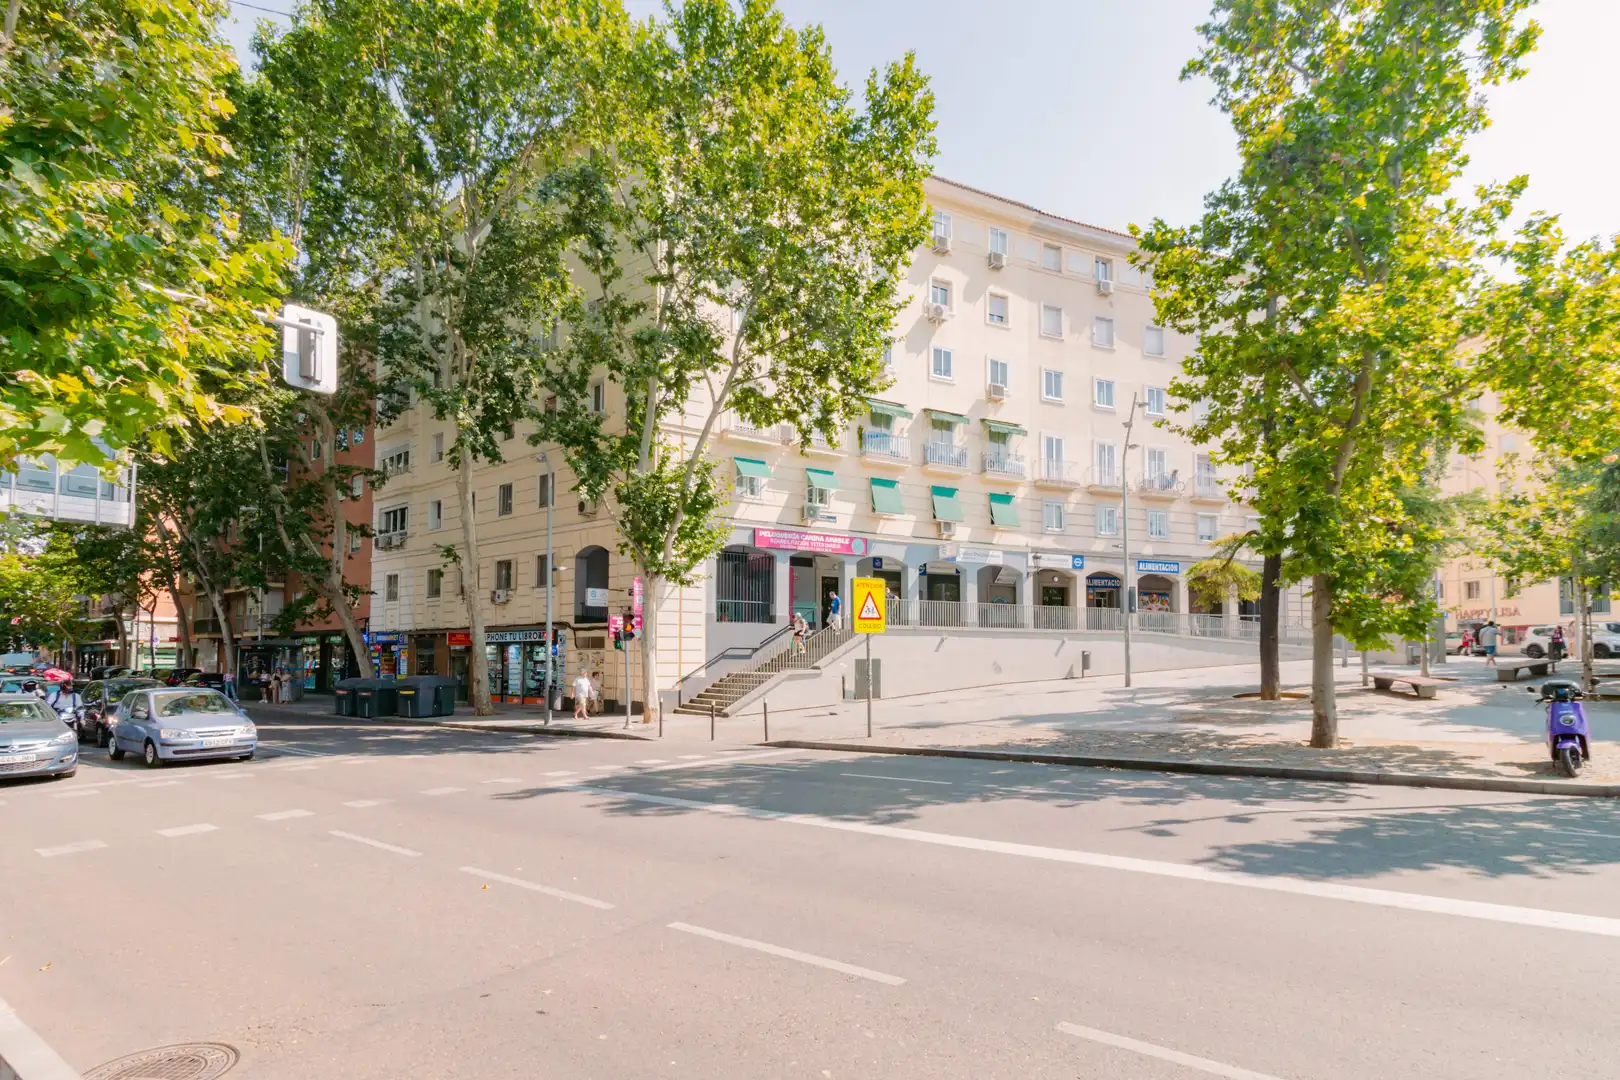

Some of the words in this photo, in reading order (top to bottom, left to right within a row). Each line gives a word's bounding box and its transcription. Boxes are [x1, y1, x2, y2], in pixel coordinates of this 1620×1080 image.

[800, 534, 825, 543] CANINA
[1138, 562, 1178, 572] ALIMENTACION
[509, 632, 517, 640] TU
[518, 631, 538, 640] LIBRO
